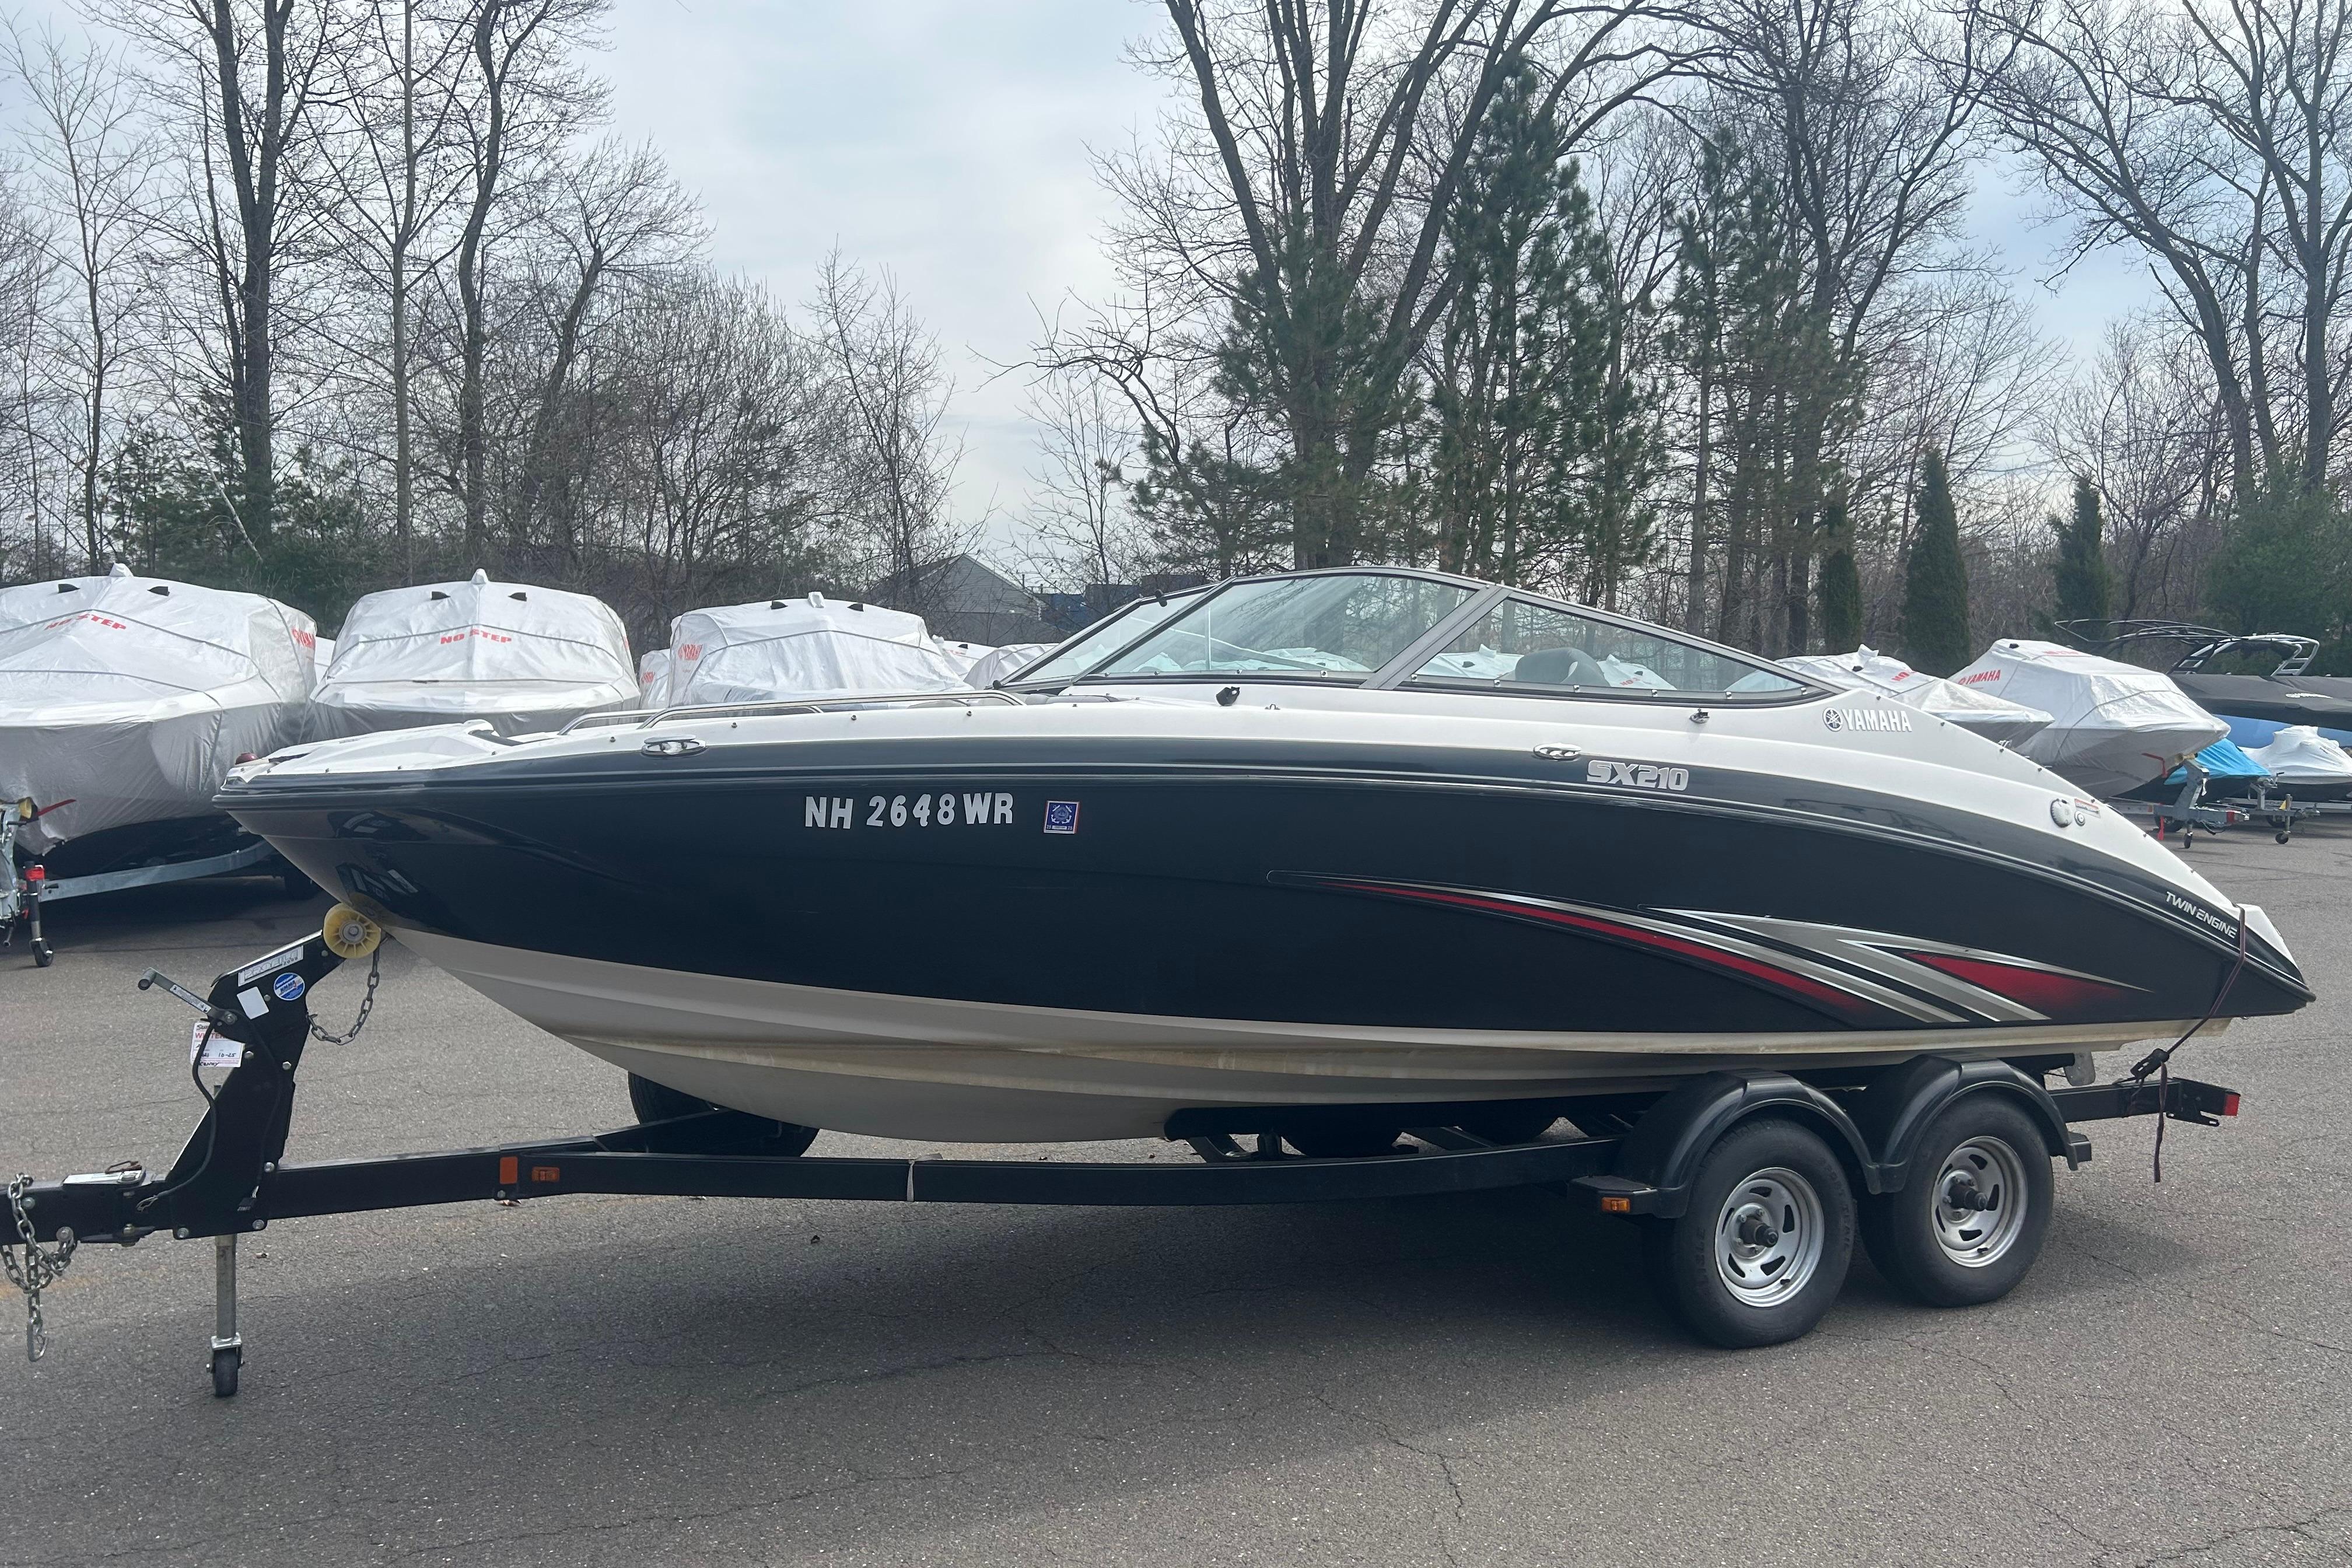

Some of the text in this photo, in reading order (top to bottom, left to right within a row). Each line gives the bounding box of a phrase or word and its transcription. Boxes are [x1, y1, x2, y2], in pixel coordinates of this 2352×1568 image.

[440, 629, 512, 644] NO STEP
[1965, 669, 2001, 684] YAMAHA
[1841, 709, 1913, 732] YAMAHA
[1586, 760, 1689, 791] SX210
[805, 796, 854, 829] NH
[2166, 891, 2238, 939] TWIN ENGINE
